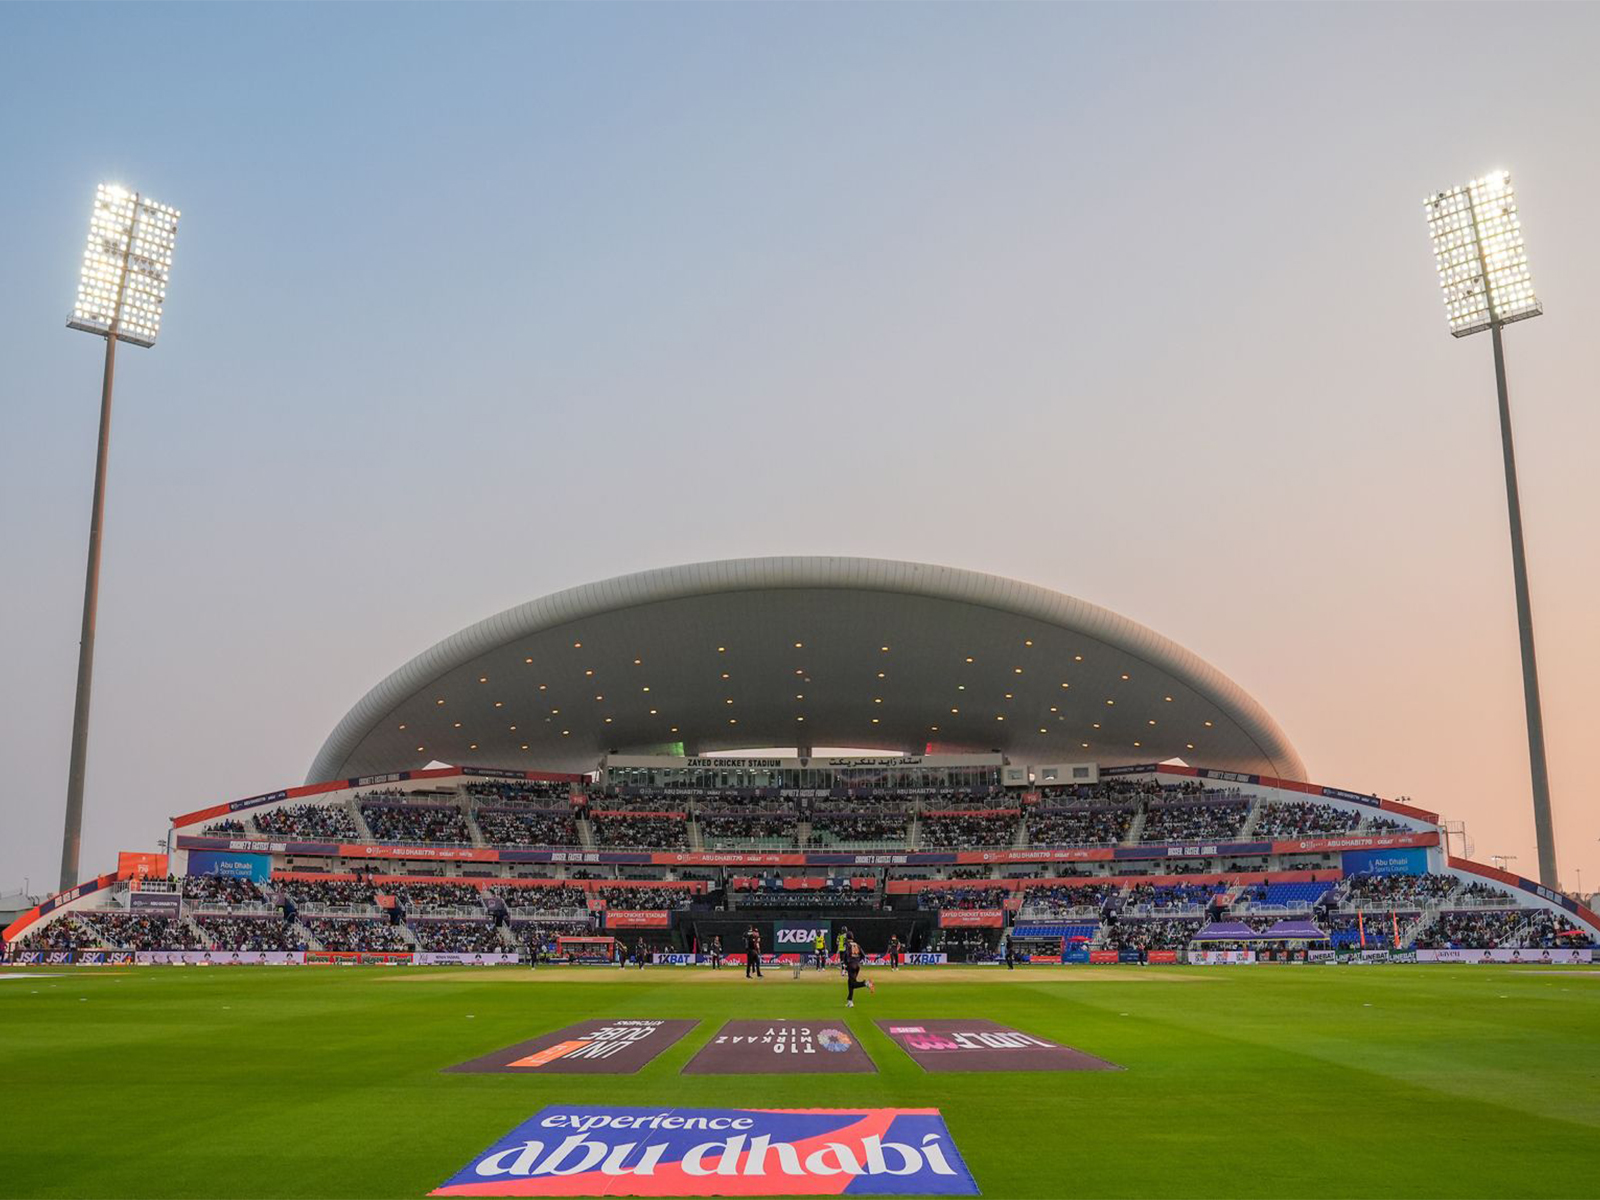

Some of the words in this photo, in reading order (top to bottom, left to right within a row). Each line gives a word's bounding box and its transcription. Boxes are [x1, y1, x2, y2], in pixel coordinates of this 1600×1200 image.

[687, 758, 712, 767] ZAYED
[713, 758, 746, 767] CRICKET
[748, 758, 781, 767] STADIUM
[220, 861, 233, 869] Abu
[1375, 858, 1387, 866] Abu
[1388, 857, 1408, 865] Dhabi
[776, 929, 828, 943] 1XBAT
[658, 954, 690, 964] 1XBAT
[909, 954, 942, 964] 1XBAT
[577, 1026, 656, 1041] QUBE
[765, 1027, 810, 1035] CITY
[715, 1035, 812, 1043] MIRKAAZ
[561, 1040, 634, 1059] UNI
[773, 1043, 816, 1053] T10
[540, 1112, 754, 1132] experience
[475, 1132, 670, 1176] abu
[681, 1133, 958, 1176] dhabi
